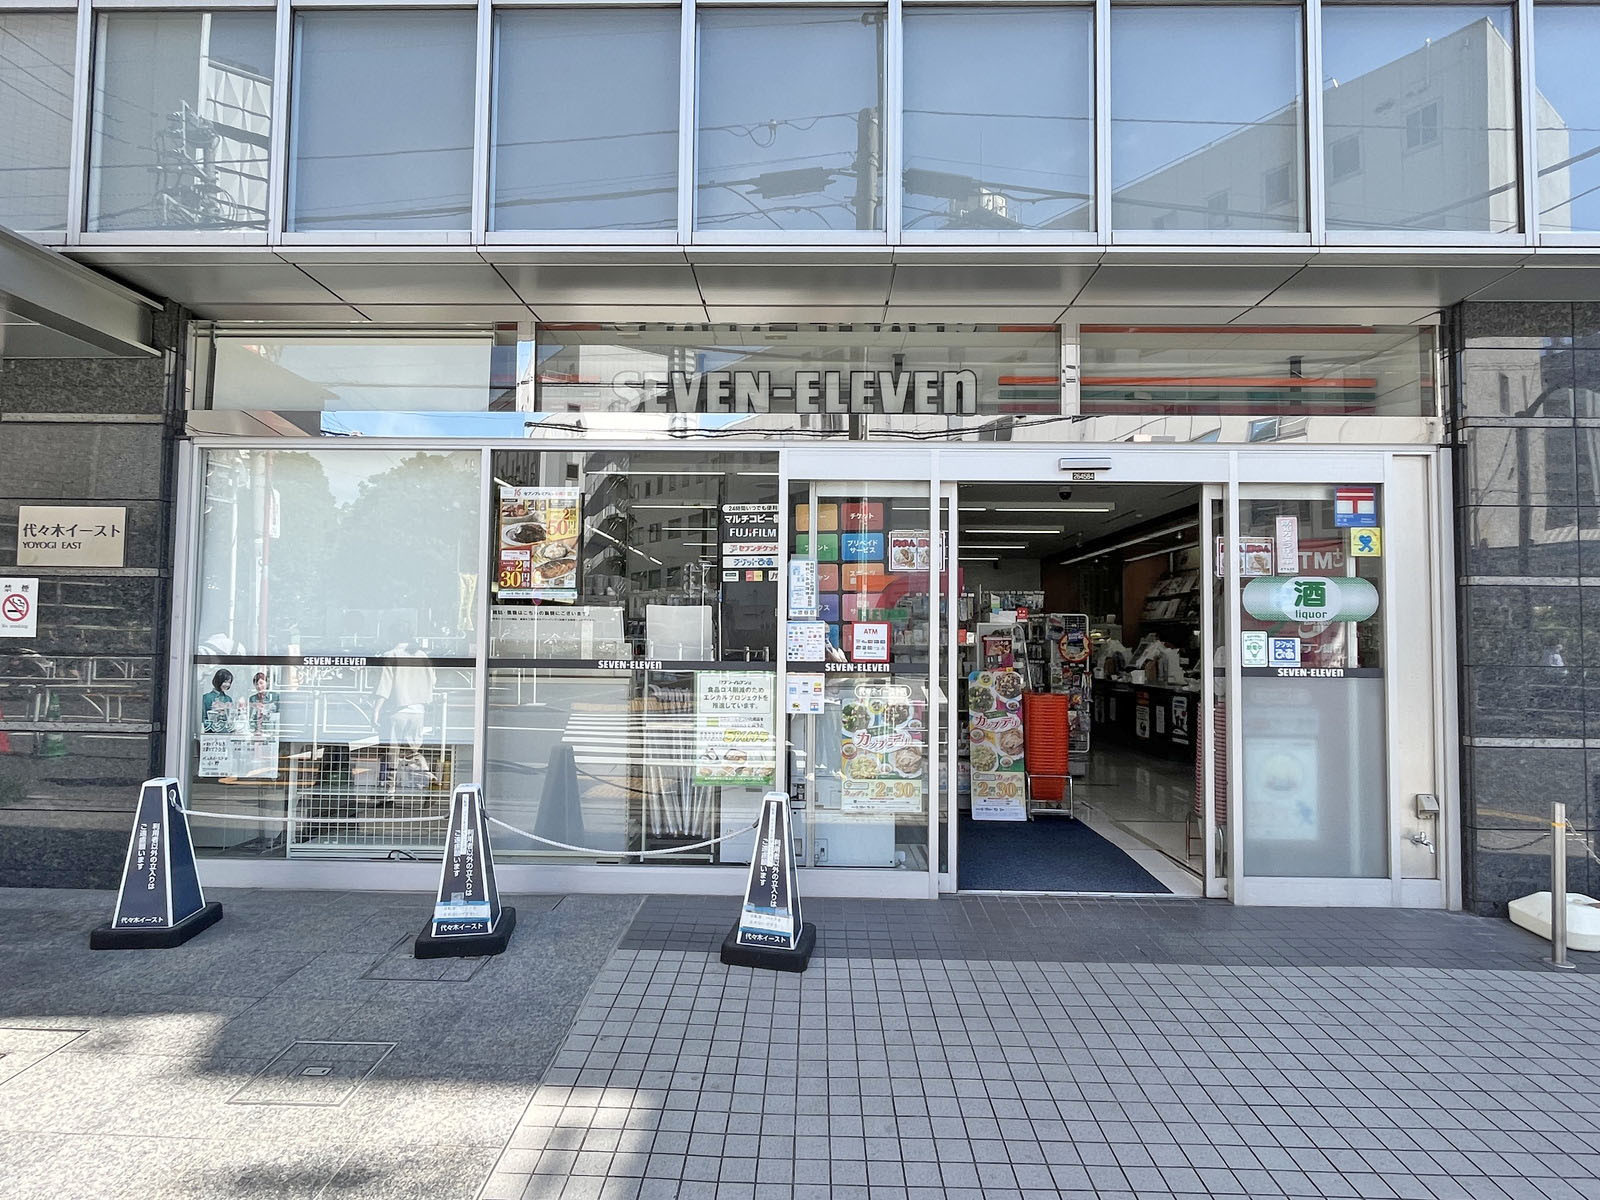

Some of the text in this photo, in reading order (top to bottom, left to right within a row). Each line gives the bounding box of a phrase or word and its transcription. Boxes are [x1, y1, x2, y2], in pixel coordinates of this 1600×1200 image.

[850, 513, 874, 521] チケット
[23, 523, 121, 538] 代々木イースト
[22, 541, 82, 549] YOYOGI EAST
[850, 546, 876, 554] サービス
[1298, 551, 1333, 569] TM
[1294, 581, 1327, 607] 酒
[1295, 610, 1328, 620] liquor
[120, 916, 164, 924] 代々木イースト
[440, 923, 484, 932] 代々木イースト
[744, 932, 787, 944] 代々木イースト
